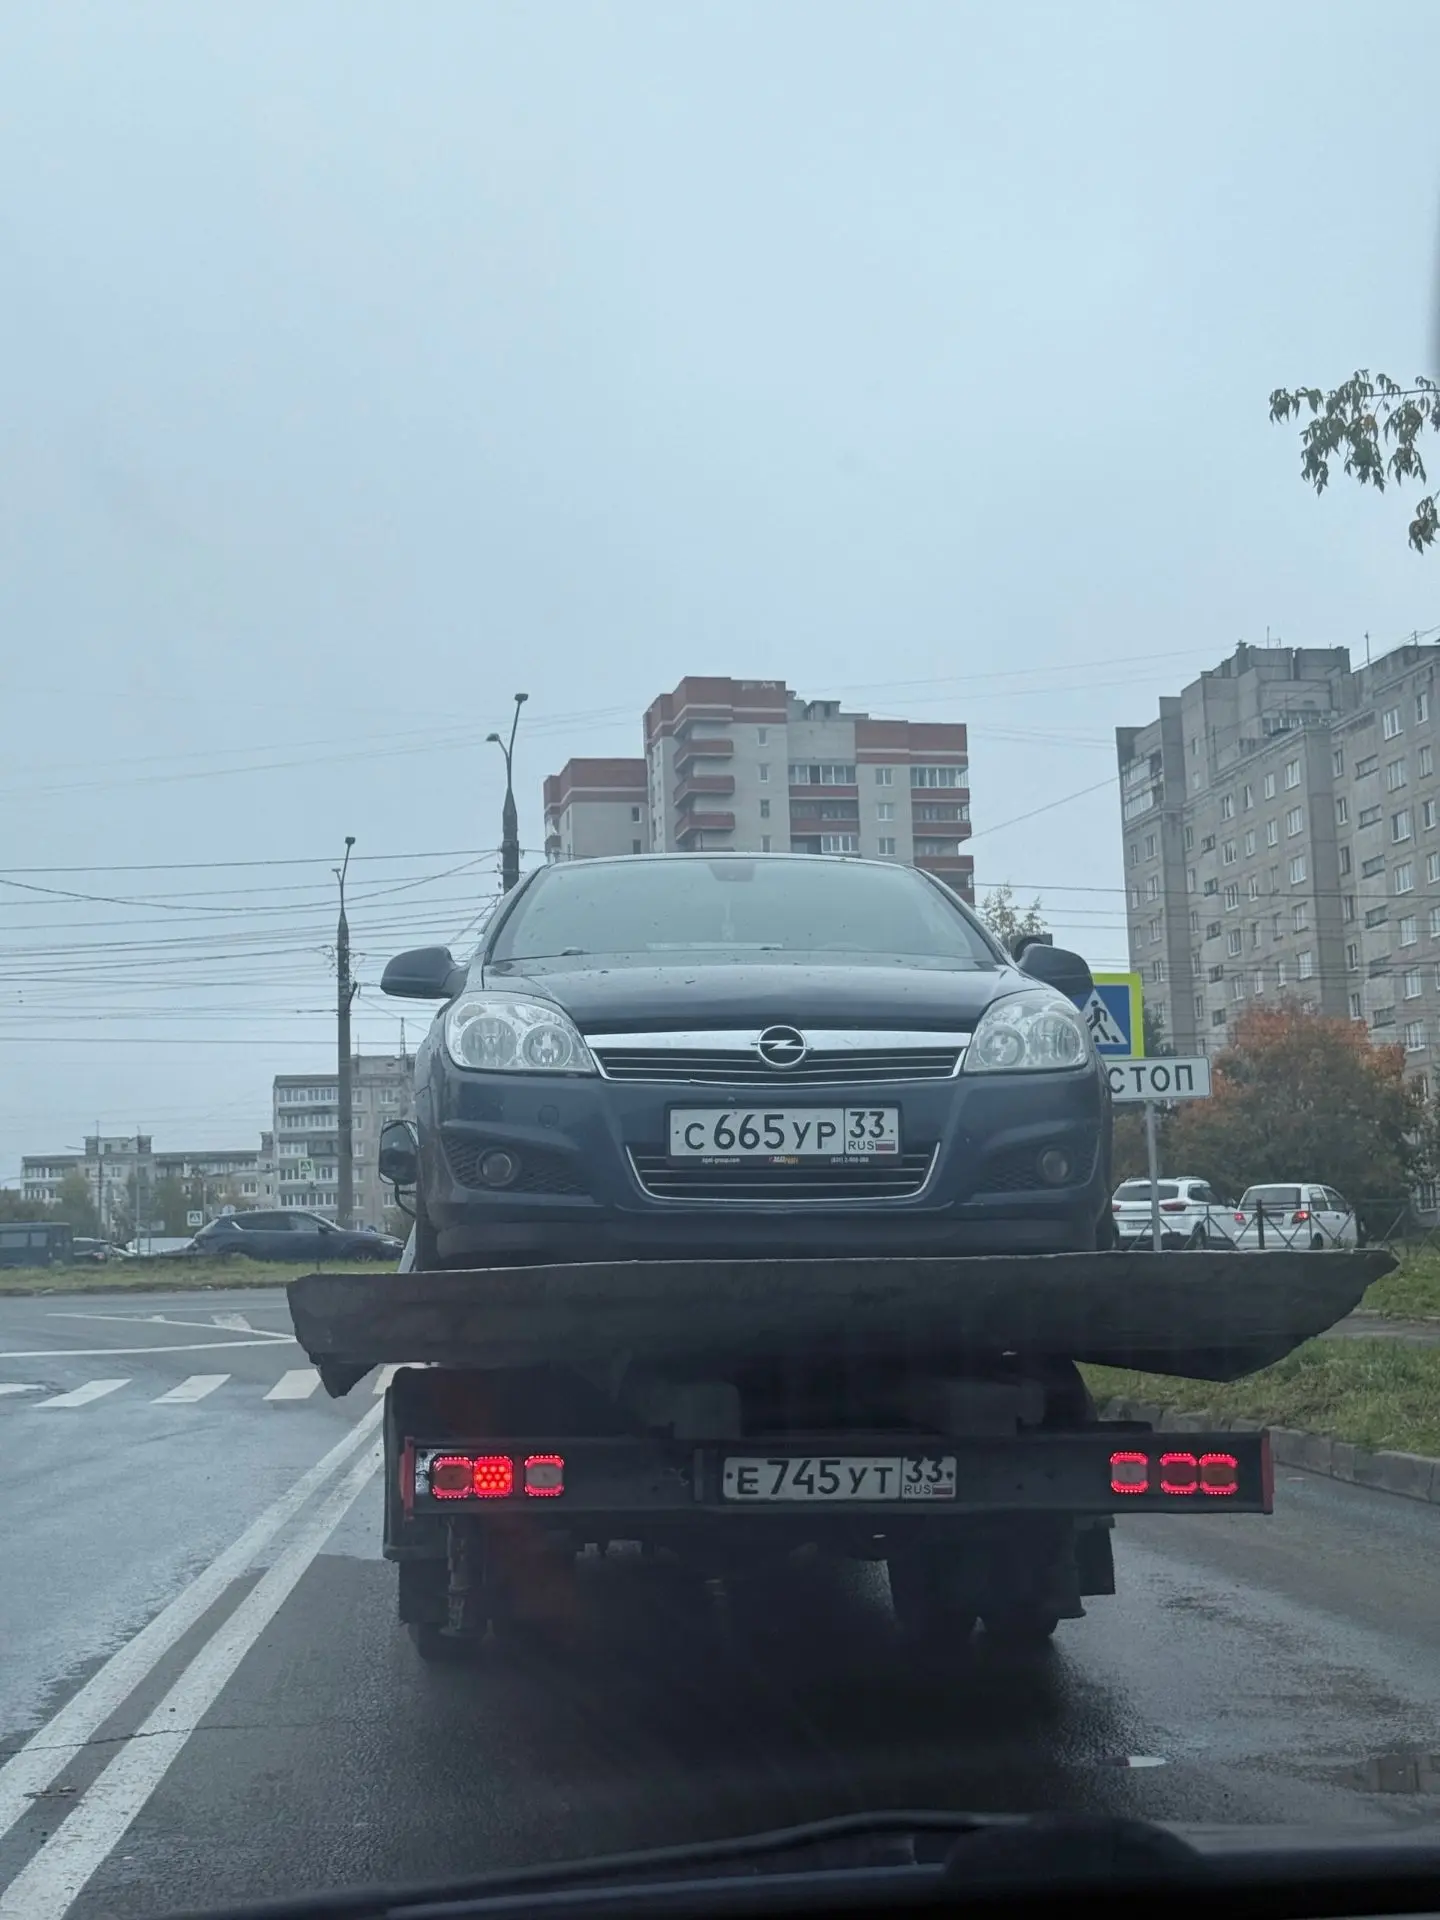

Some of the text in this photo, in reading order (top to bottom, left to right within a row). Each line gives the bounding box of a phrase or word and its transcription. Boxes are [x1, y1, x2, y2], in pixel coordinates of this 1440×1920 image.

[1108, 1065, 1194, 1094] СТОП
[849, 1111, 885, 1138] 33
[848, 1140, 875, 1150] RUS
[906, 1456, 943, 1483] 33
[904, 1485, 931, 1495] RUS
